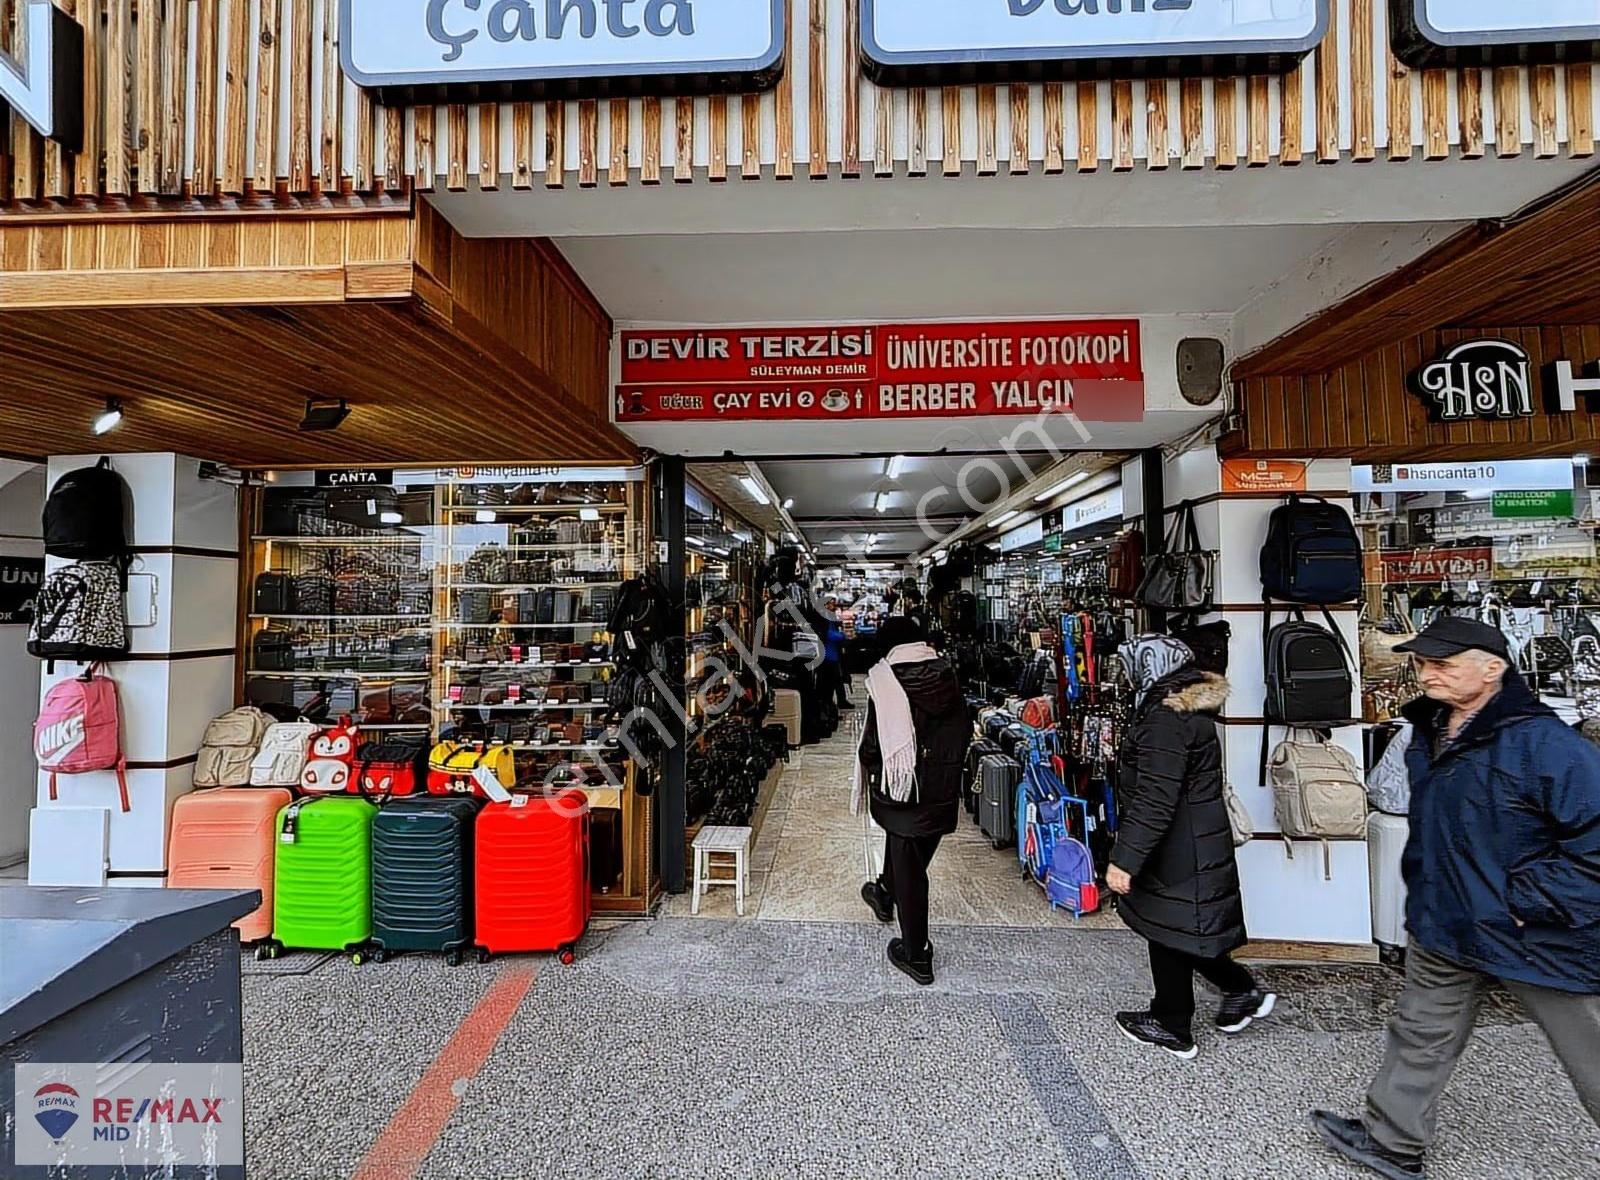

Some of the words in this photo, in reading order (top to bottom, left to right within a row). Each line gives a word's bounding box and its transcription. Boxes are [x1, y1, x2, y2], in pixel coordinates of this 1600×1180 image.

[425, 0, 695, 61] Çanta
[627, 333, 730, 360] DEVİR
[740, 329, 873, 359] TERZİSİ
[887, 332, 1013, 369] ÜNİVERSİTE
[1021, 329, 1130, 367] FOTOKOPİ
[750, 364, 822, 376] SÜLEYMAN
[826, 361, 867, 375] DEMİR
[713, 392, 752, 414] ÇAY
[759, 388, 791, 409] EVİ
[879, 382, 977, 412] BERBER
[329, 472, 377, 486] ÇANTA
[1410, 466, 1495, 481] hsncanta10
